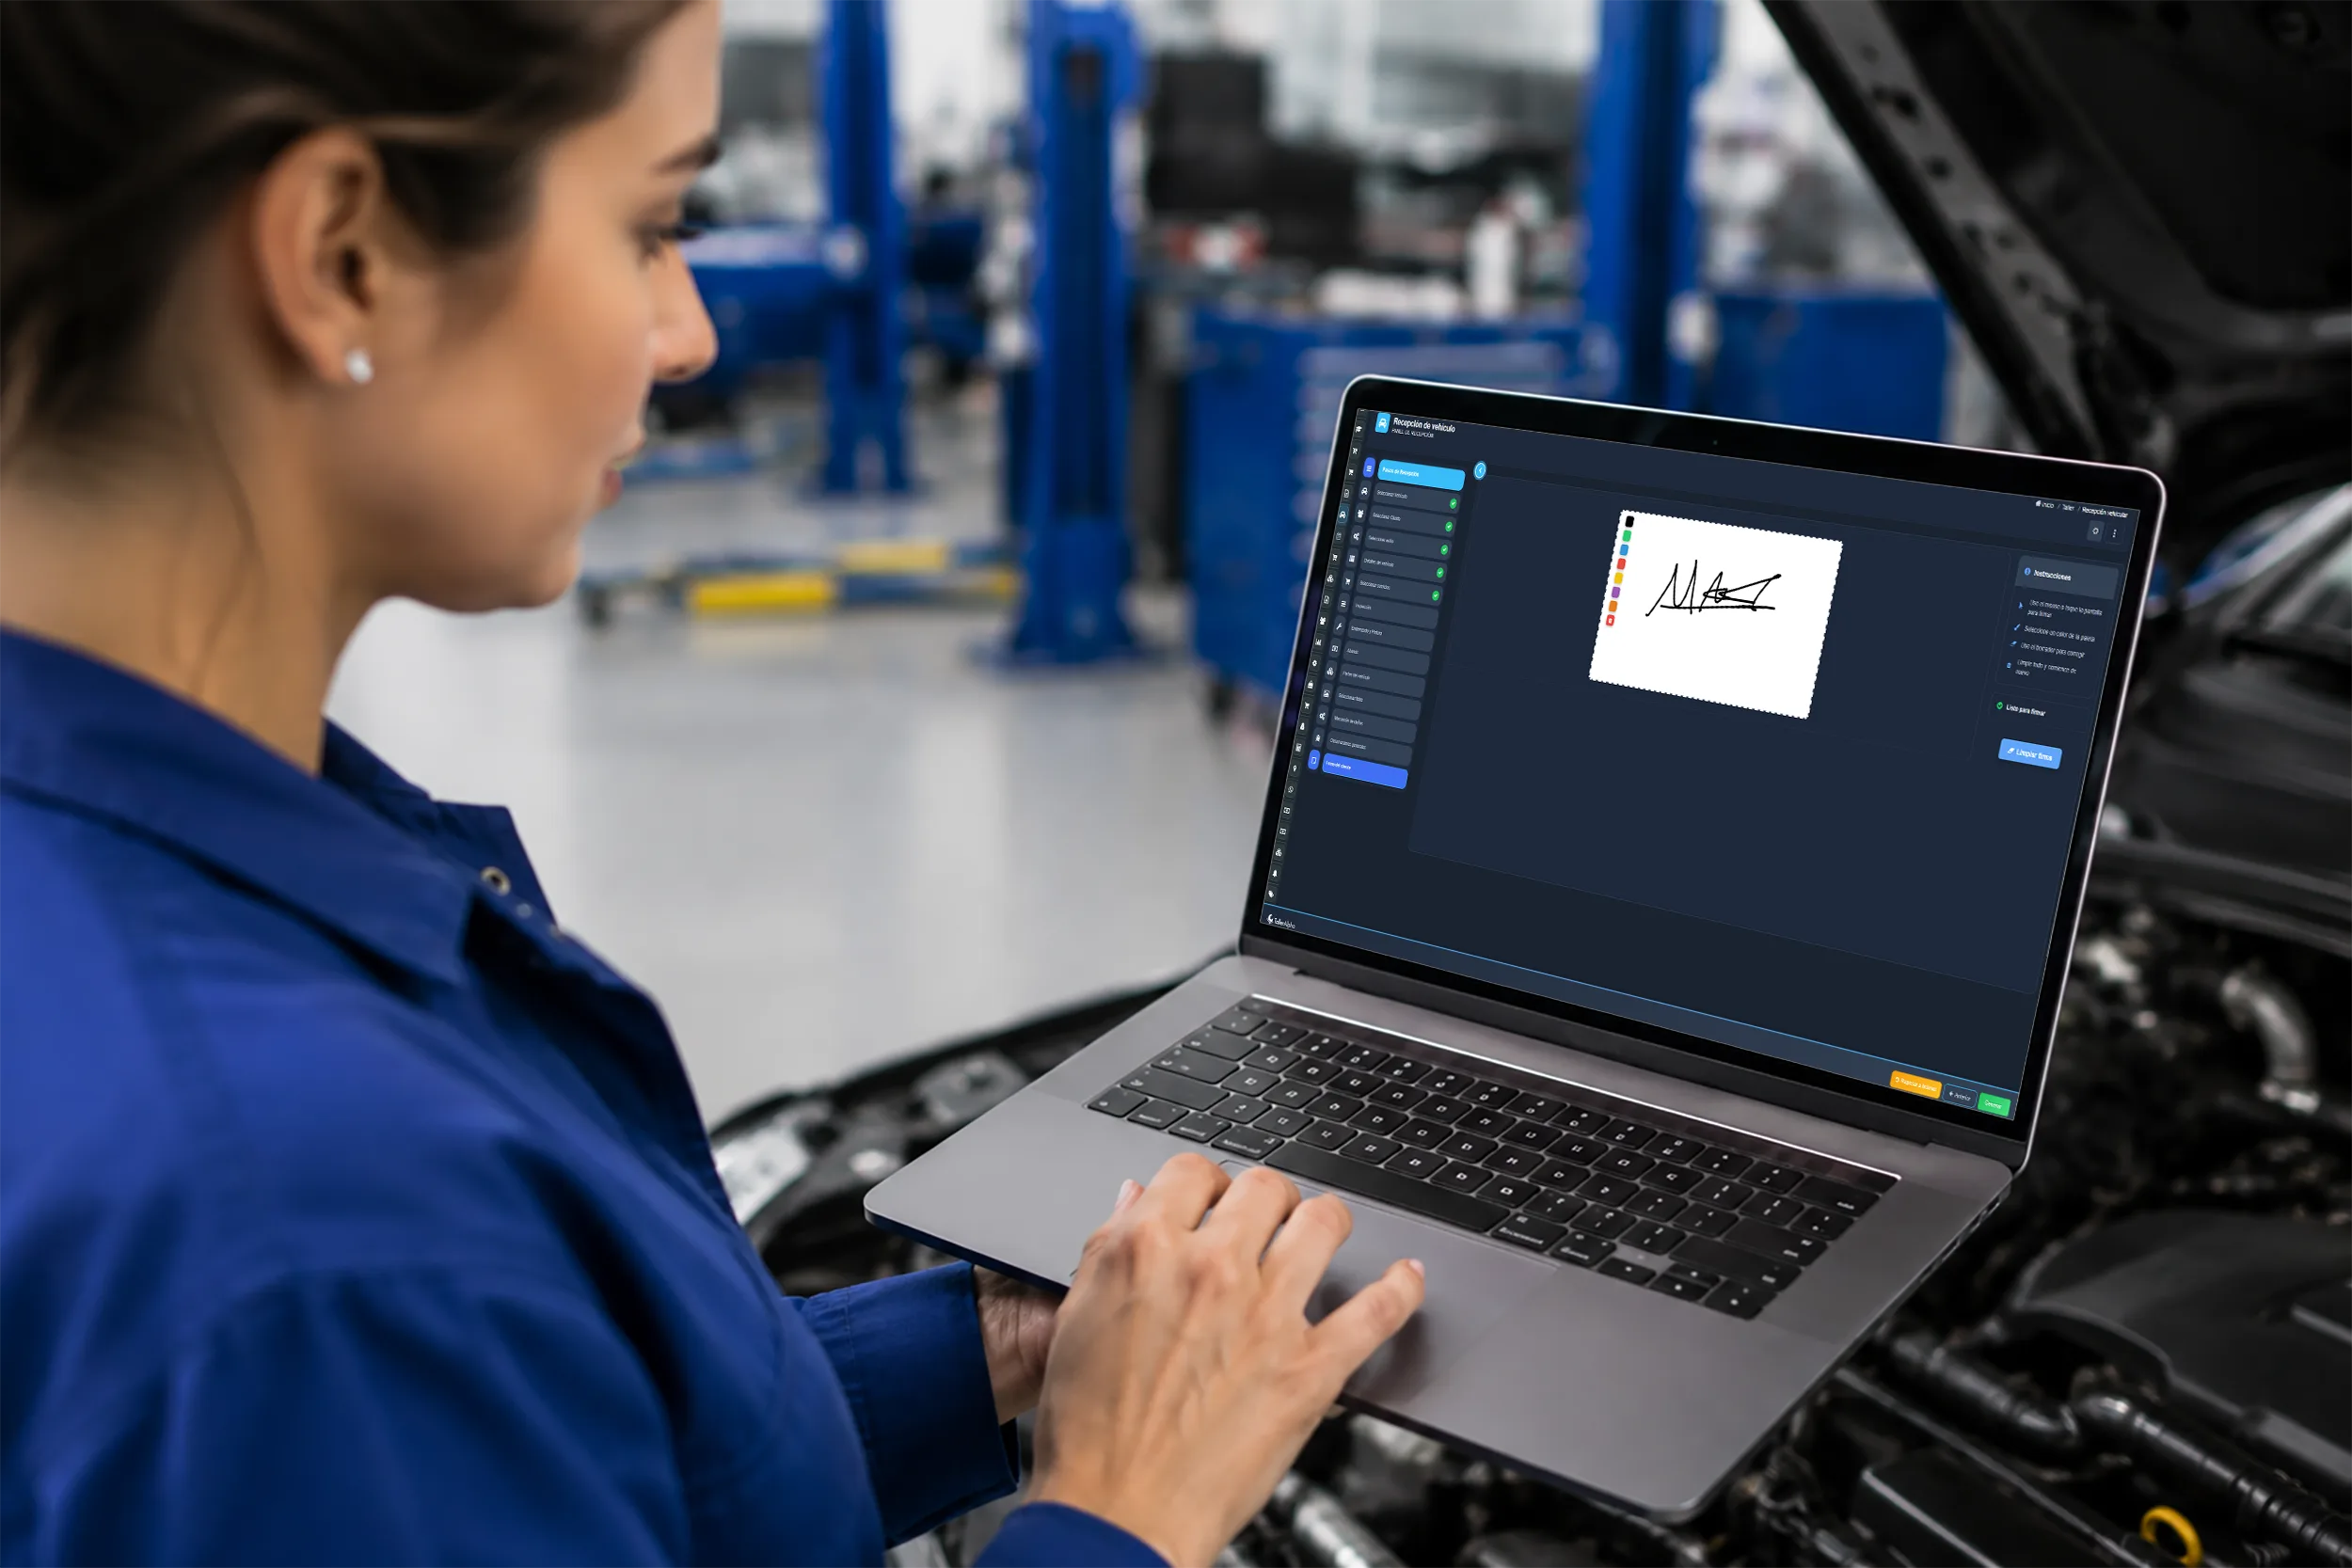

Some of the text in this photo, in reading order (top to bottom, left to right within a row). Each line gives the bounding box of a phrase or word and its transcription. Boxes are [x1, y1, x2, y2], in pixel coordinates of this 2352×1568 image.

[1393, 417, 1422, 428] Recepción
[1423, 421, 1431, 430] de
[2082, 507, 2106, 515] Recepción
[2033, 569, 2072, 581] Instrucciones
[2016, 749, 2038, 758] Limpiar
